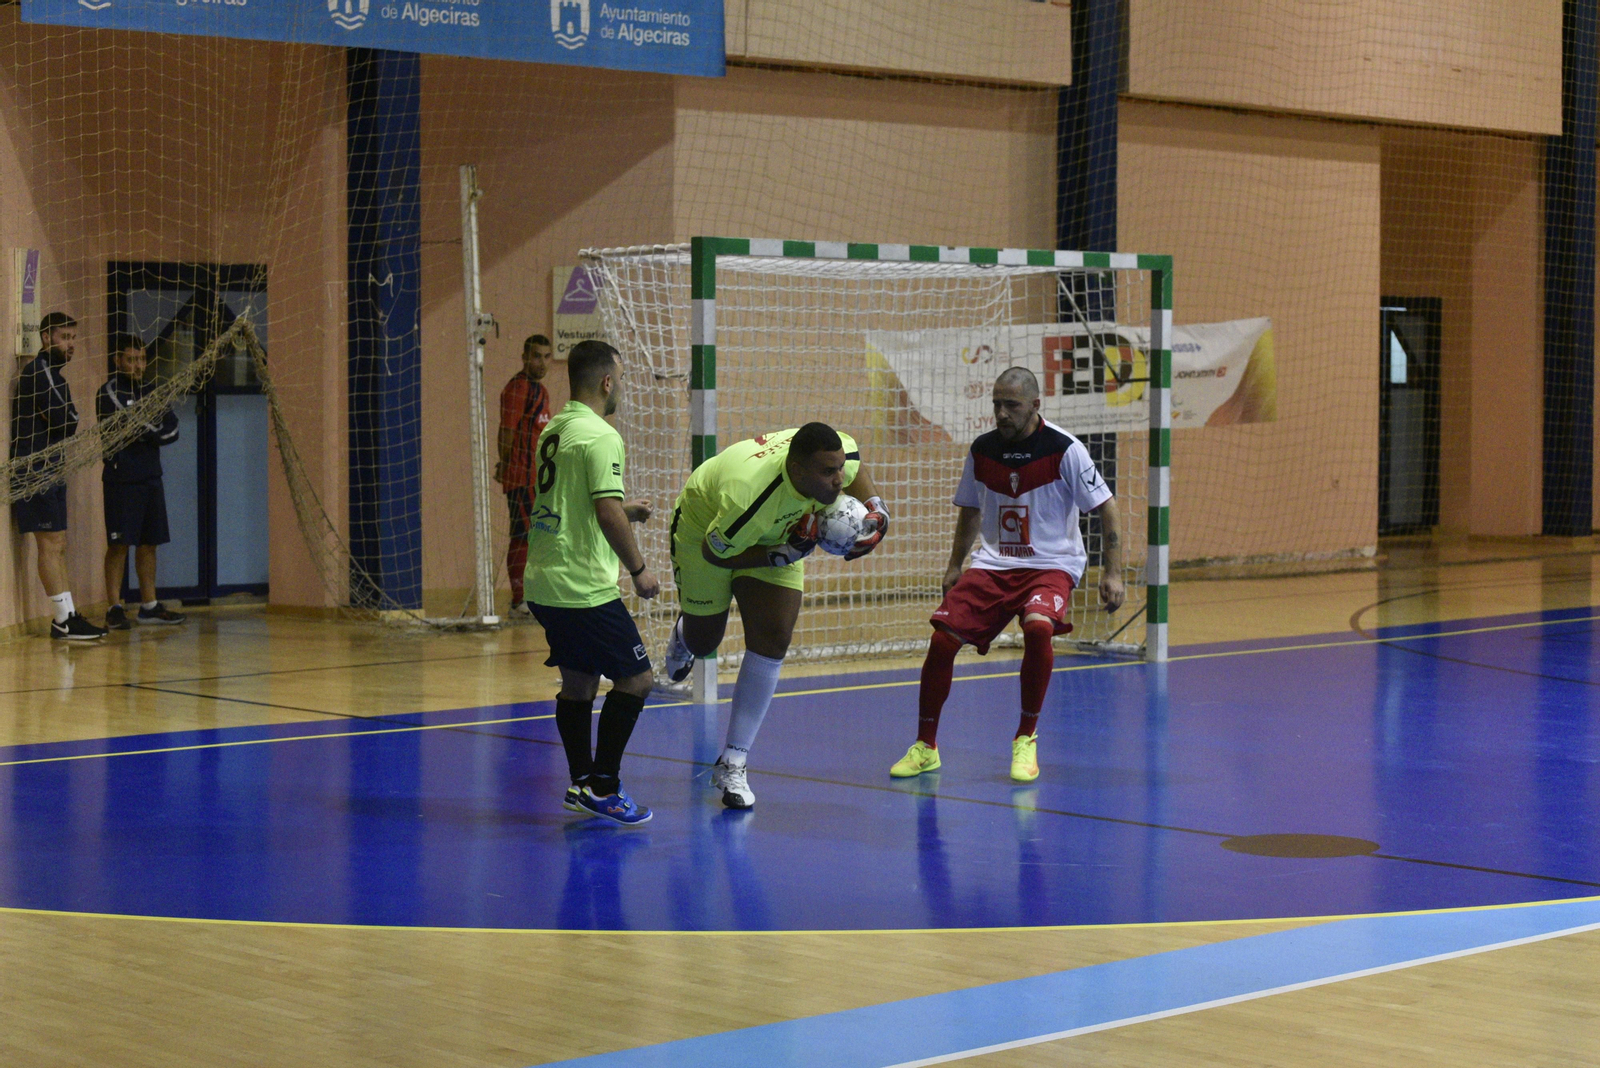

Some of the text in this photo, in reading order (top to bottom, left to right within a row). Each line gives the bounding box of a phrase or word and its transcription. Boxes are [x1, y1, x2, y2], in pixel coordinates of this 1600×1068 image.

[381, 2, 480, 27] de Algeciras
[599, 3, 691, 26] Ayuntamiento
[600, 23, 690, 46] de Algeciras
[538, 434, 560, 494] 8
